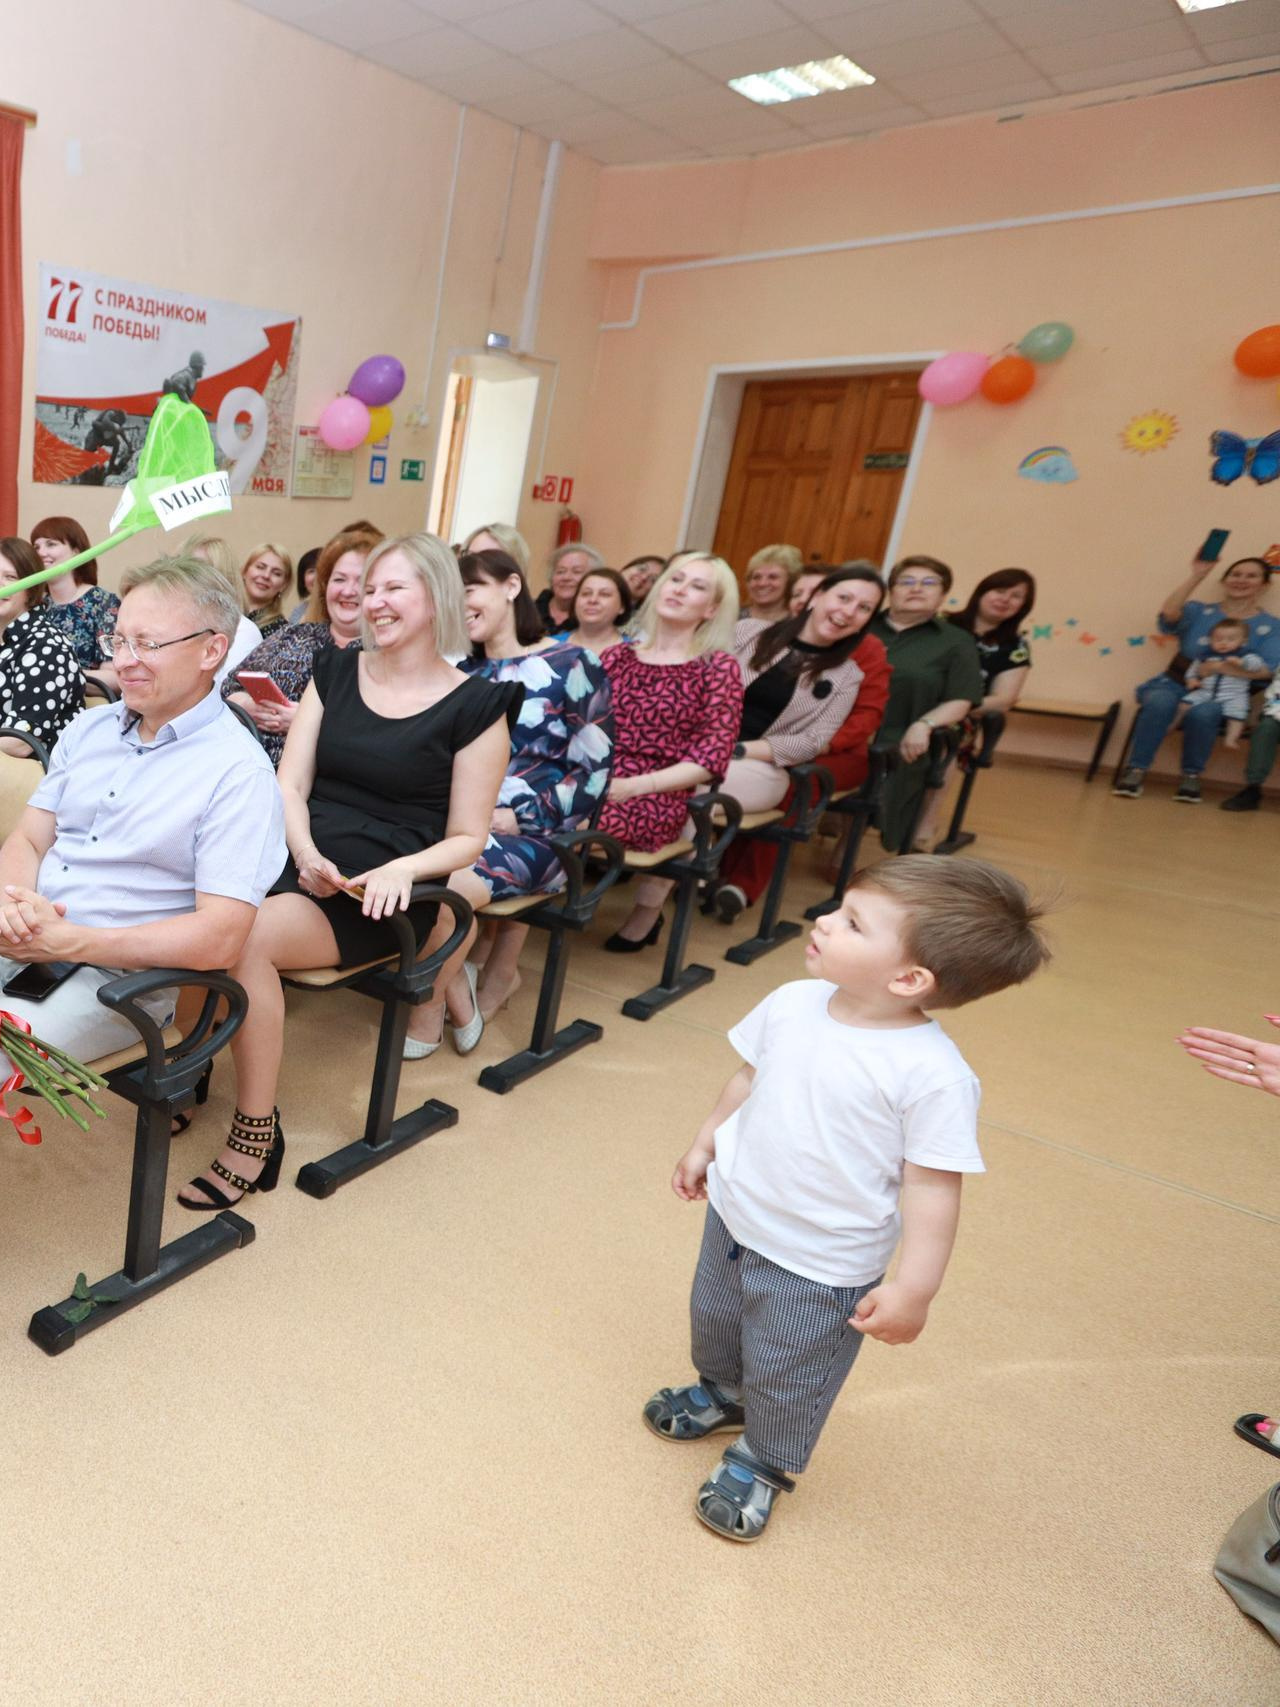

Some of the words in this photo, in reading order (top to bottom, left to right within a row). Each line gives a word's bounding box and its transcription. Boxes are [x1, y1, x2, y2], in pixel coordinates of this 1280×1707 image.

[47, 276, 83, 323] 77
[94, 288, 104, 305] С
[107, 291, 208, 325] ПРАЗДНИКОМ
[45, 326, 87, 343] ПОБЕДА!
[92, 314, 161, 341] ПОБЕДЫ!
[217, 386, 269, 496] 9
